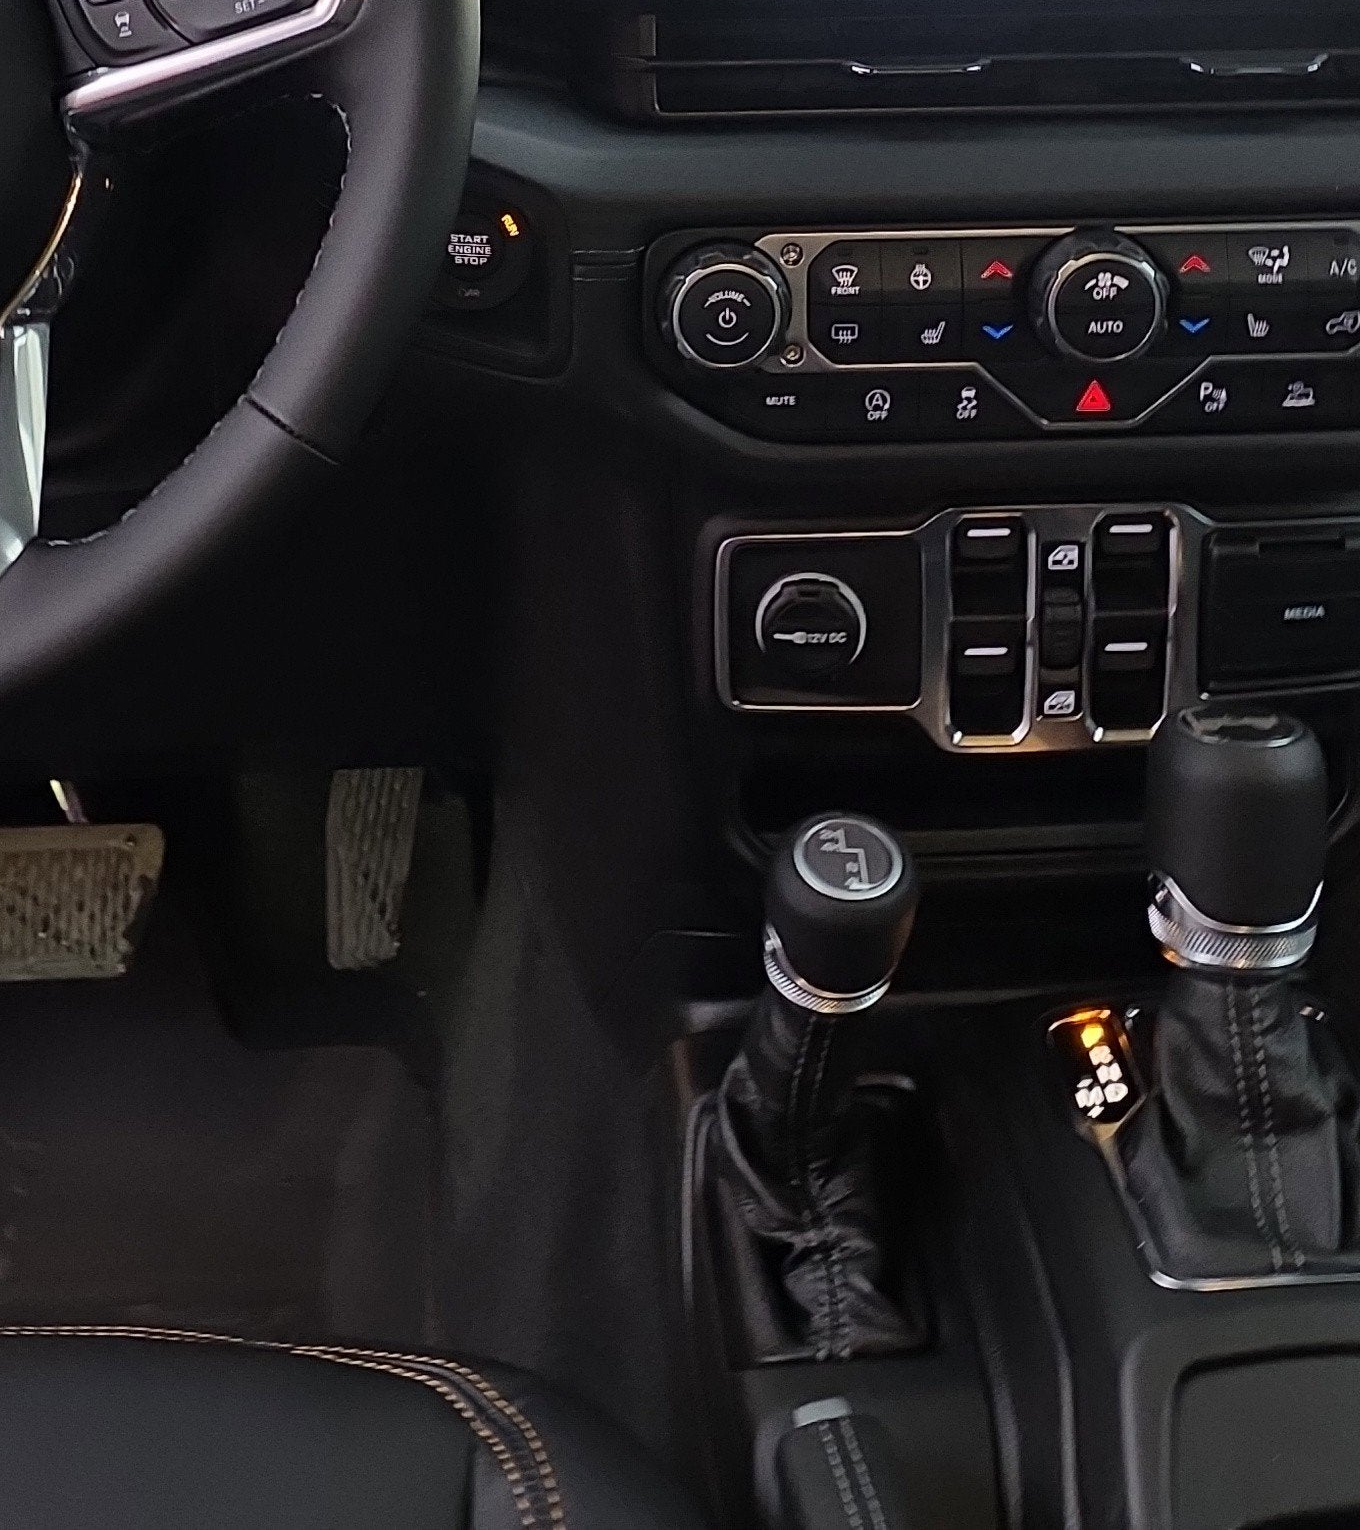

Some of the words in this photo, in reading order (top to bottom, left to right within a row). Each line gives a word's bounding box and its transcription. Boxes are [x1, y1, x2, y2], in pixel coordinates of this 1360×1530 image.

[450, 233, 489, 244] START
[447, 244, 492, 255] ENGINE
[454, 255, 488, 266] STOP
[1329, 258, 1358, 277] A/C
[831, 285, 861, 296] FRONT
[1093, 286, 1118, 300] OFF
[708, 290, 746, 303] VOLUME
[1088, 320, 1124, 334] AUTO
[765, 395, 796, 406] MUTE
[867, 410, 889, 421] OFF
[956, 409, 978, 420] OFF
